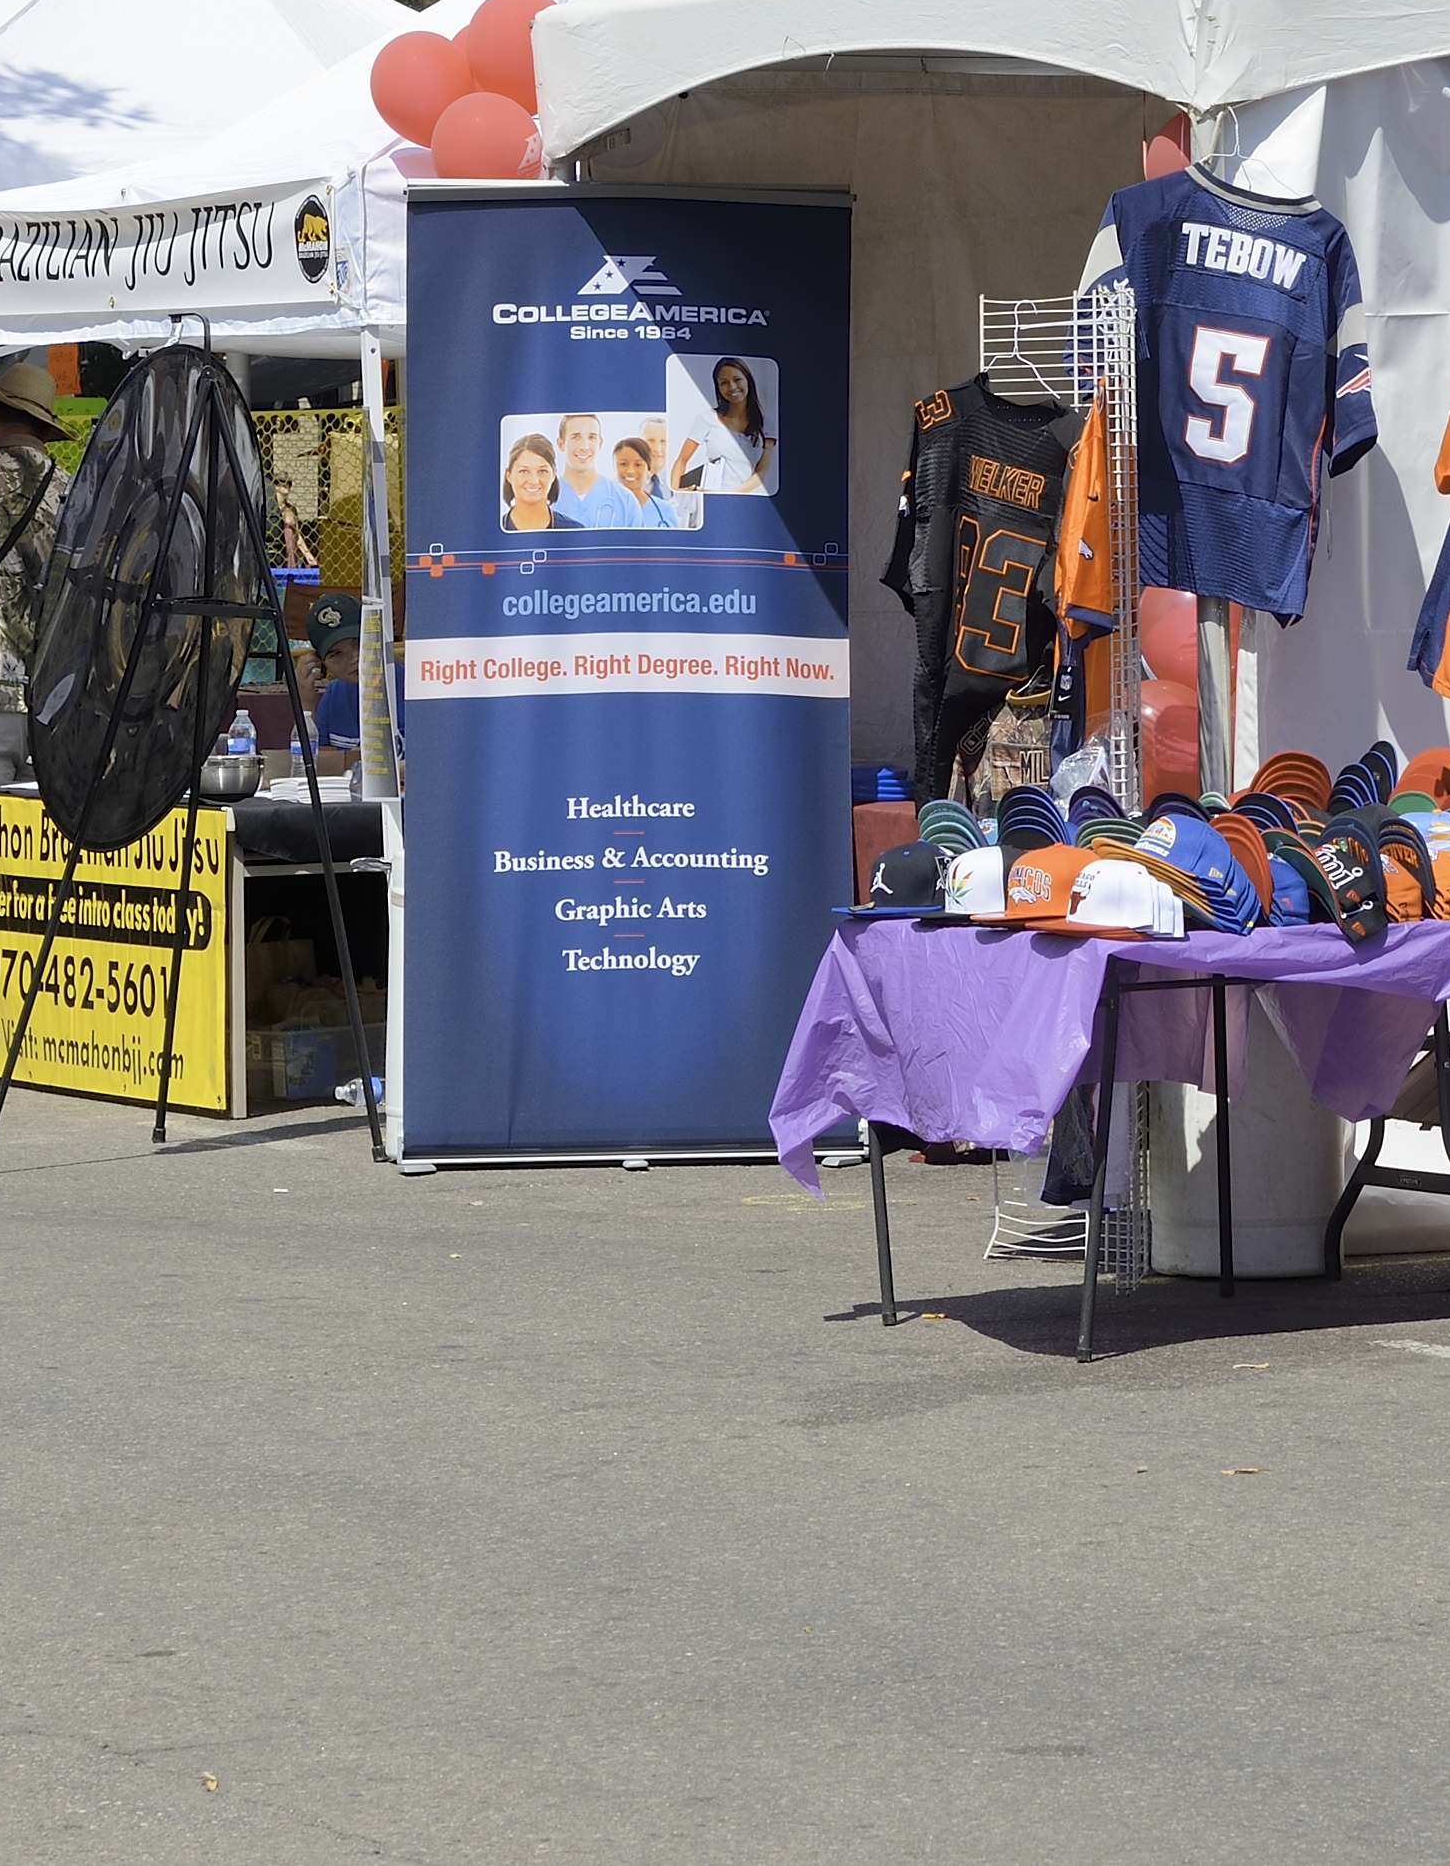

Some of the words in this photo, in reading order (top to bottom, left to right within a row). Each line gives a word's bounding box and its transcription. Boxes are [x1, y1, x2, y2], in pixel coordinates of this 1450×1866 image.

[124, 211, 179, 291] JIU
[183, 200, 275, 287] JITSU
[1181, 221, 1307, 290] TEBOW
[570, 325, 629, 340] Since
[634, 325, 692, 340] 1964
[1184, 324, 1271, 466] 5
[502, 586, 756, 620] collegeamerica.edu
[420, 659, 477, 685] Right
[483, 657, 568, 682] College.
[574, 654, 631, 680] Right
[637, 653, 718, 680] Degree.
[725, 655, 781, 681] Right
[786, 657, 834, 680] Now.
[566, 794, 695, 820] Healthcare
[169, 817, 219, 875] Jisu
[493, 850, 595, 873] Business
[601, 847, 626, 869] &
[630, 846, 769, 876] Accounting
[12, 879, 35, 919] for
[35, 893, 46, 922] a
[47, 882, 76, 925] fee
[78, 885, 111, 928] intro
[112, 889, 151, 932] class
[152, 895, 205, 947] tody!
[554, 895, 652, 927] Graphic
[656, 896, 707, 919] Arts
[561, 946, 701, 977] Technology
